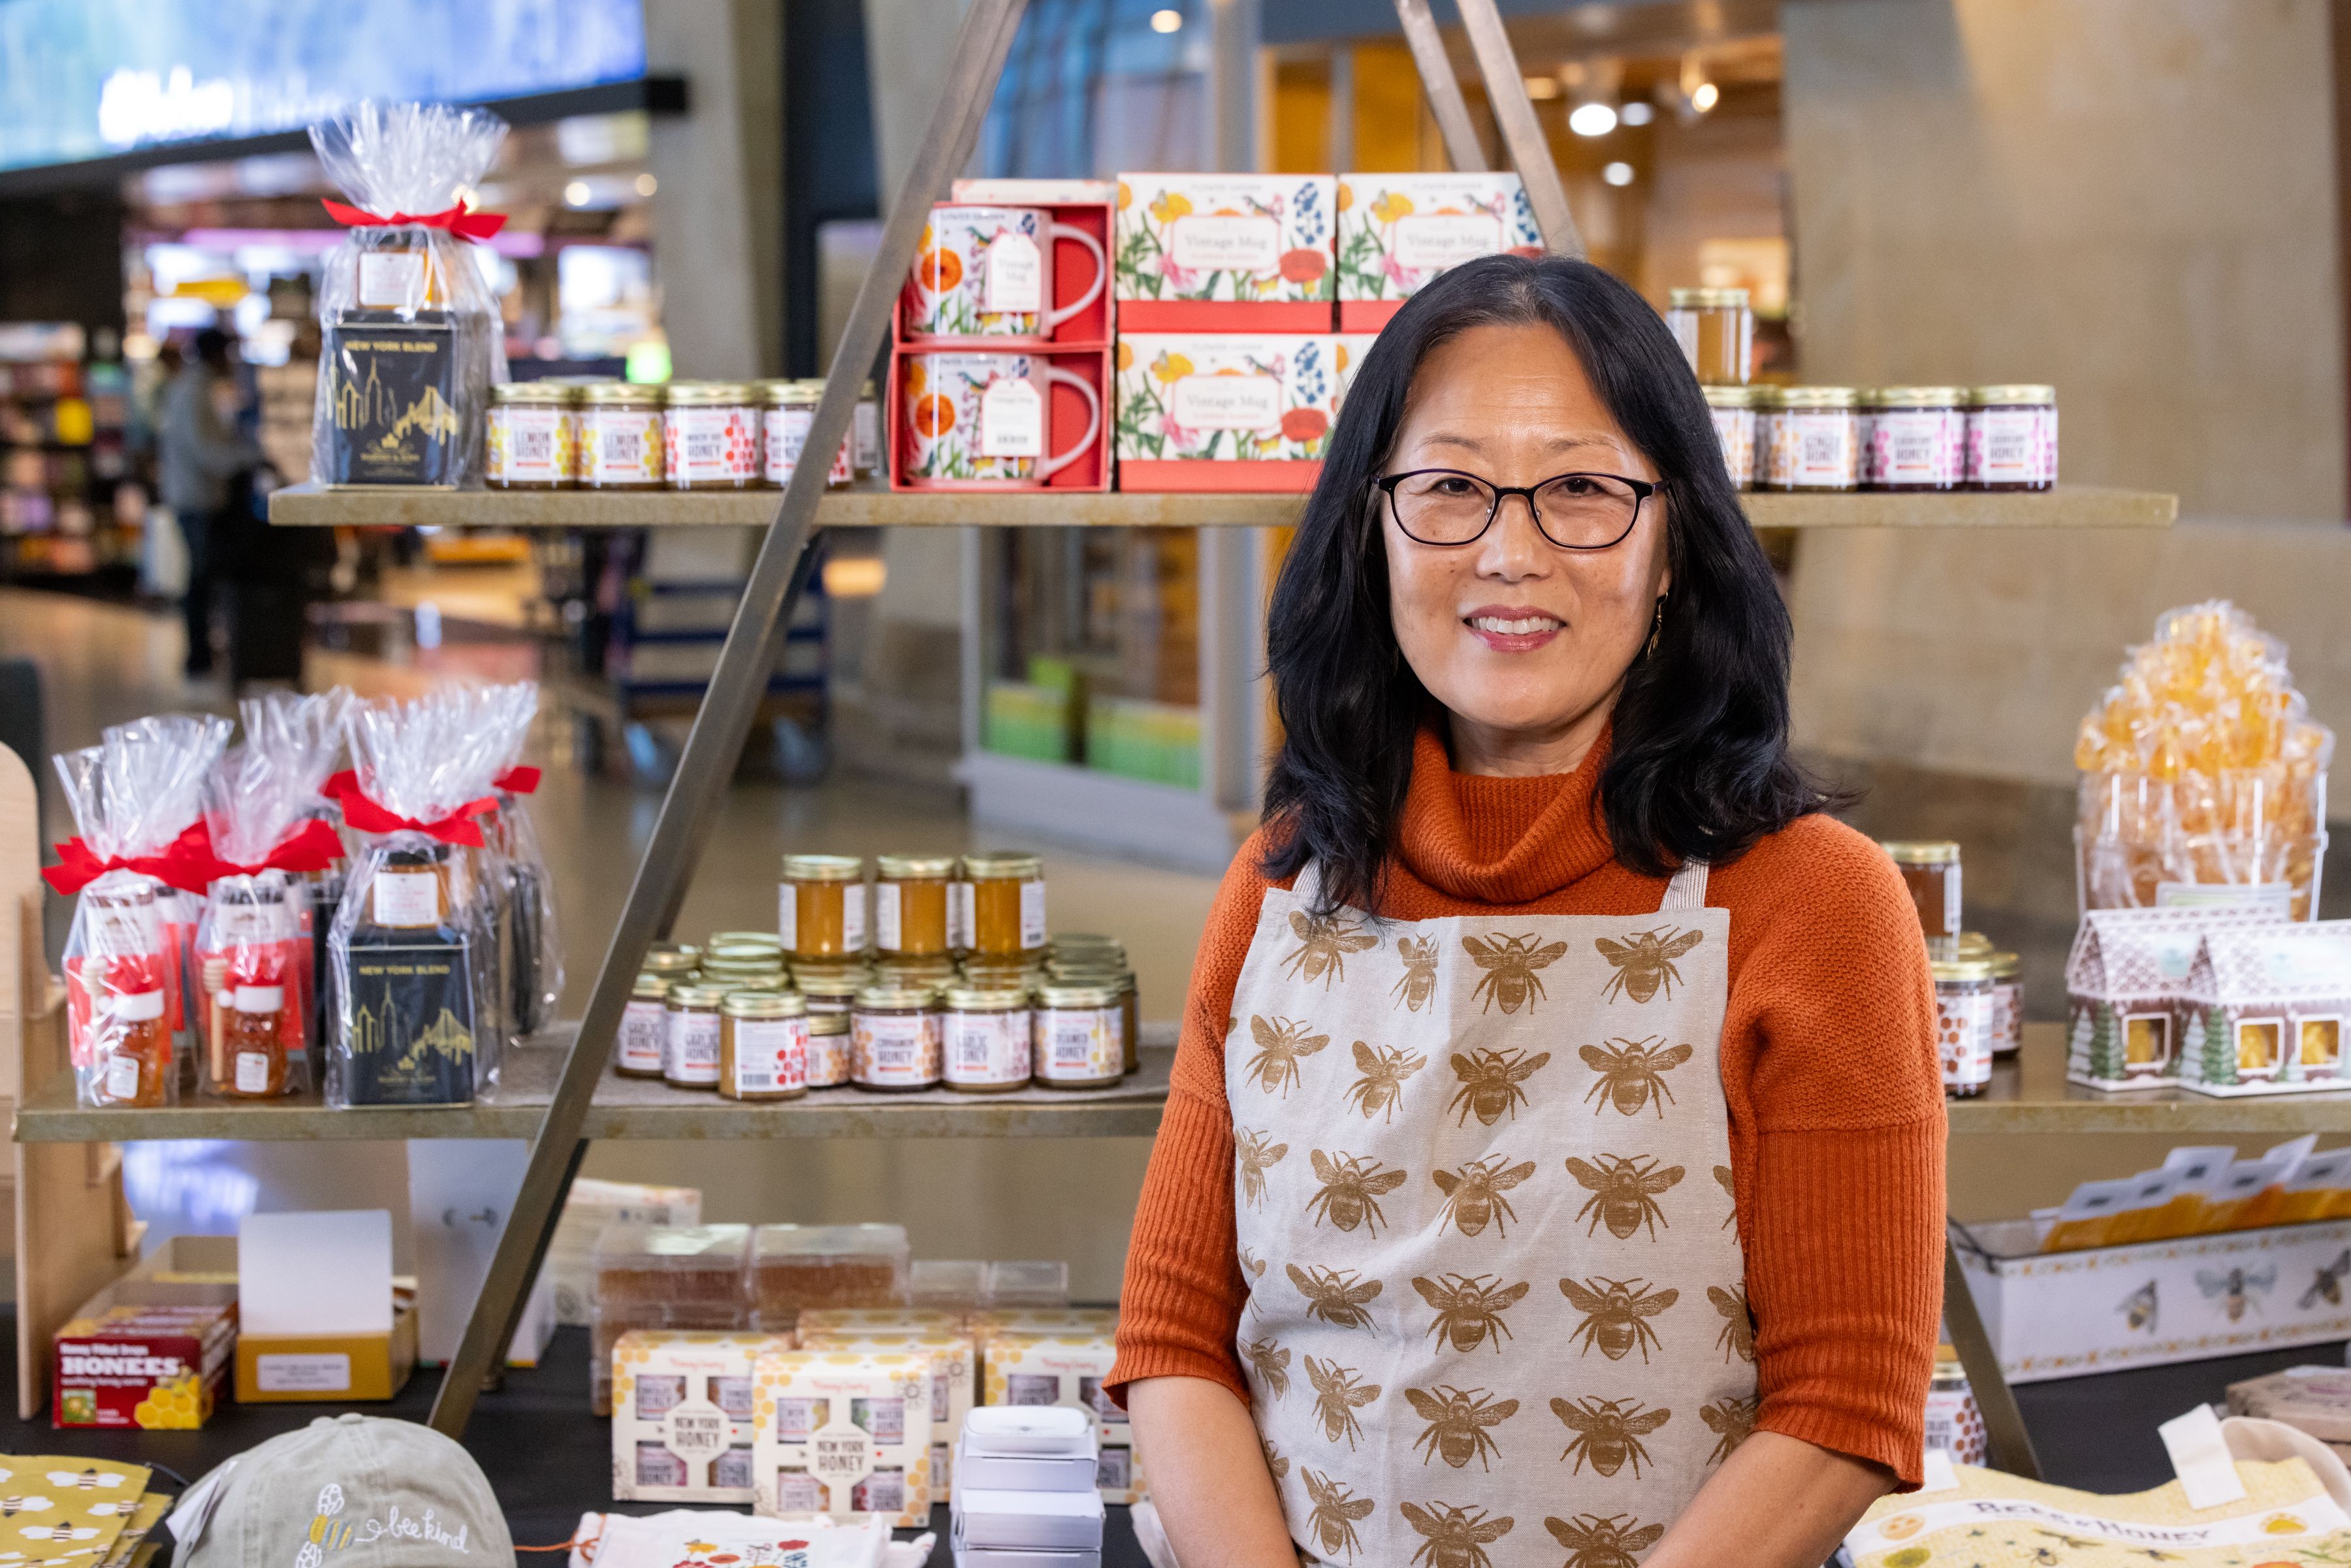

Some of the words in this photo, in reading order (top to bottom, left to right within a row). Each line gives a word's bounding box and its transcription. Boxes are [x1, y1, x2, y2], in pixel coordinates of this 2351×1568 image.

[1185, 236, 1234, 249] Vintage
[1238, 236, 1267, 251] Mug
[345, 341, 371, 351] NEW
[372, 341, 401, 352] YORK
[402, 342, 438, 353] BLEND
[1187, 395, 1235, 409] Vintage
[1239, 395, 1268, 411] Mug
[359, 965, 385, 976] NEW
[386, 965, 413, 976] YORK
[415, 965, 451, 976] BLEND
[877, 1051, 912, 1063] HONEY
[1055, 1046, 1087, 1059] HONEY
[61, 1356, 180, 1376] HONEES
[675, 1417, 694, 1429] NEW
[697, 1417, 720, 1430] YORK
[675, 1431, 720, 1448] HONEY
[817, 1440, 838, 1454] NEW
[841, 1440, 865, 1454] YORK
[818, 1455, 865, 1471] HONEY
[389, 1505, 423, 1539] bee
[422, 1508, 471, 1554] kind
